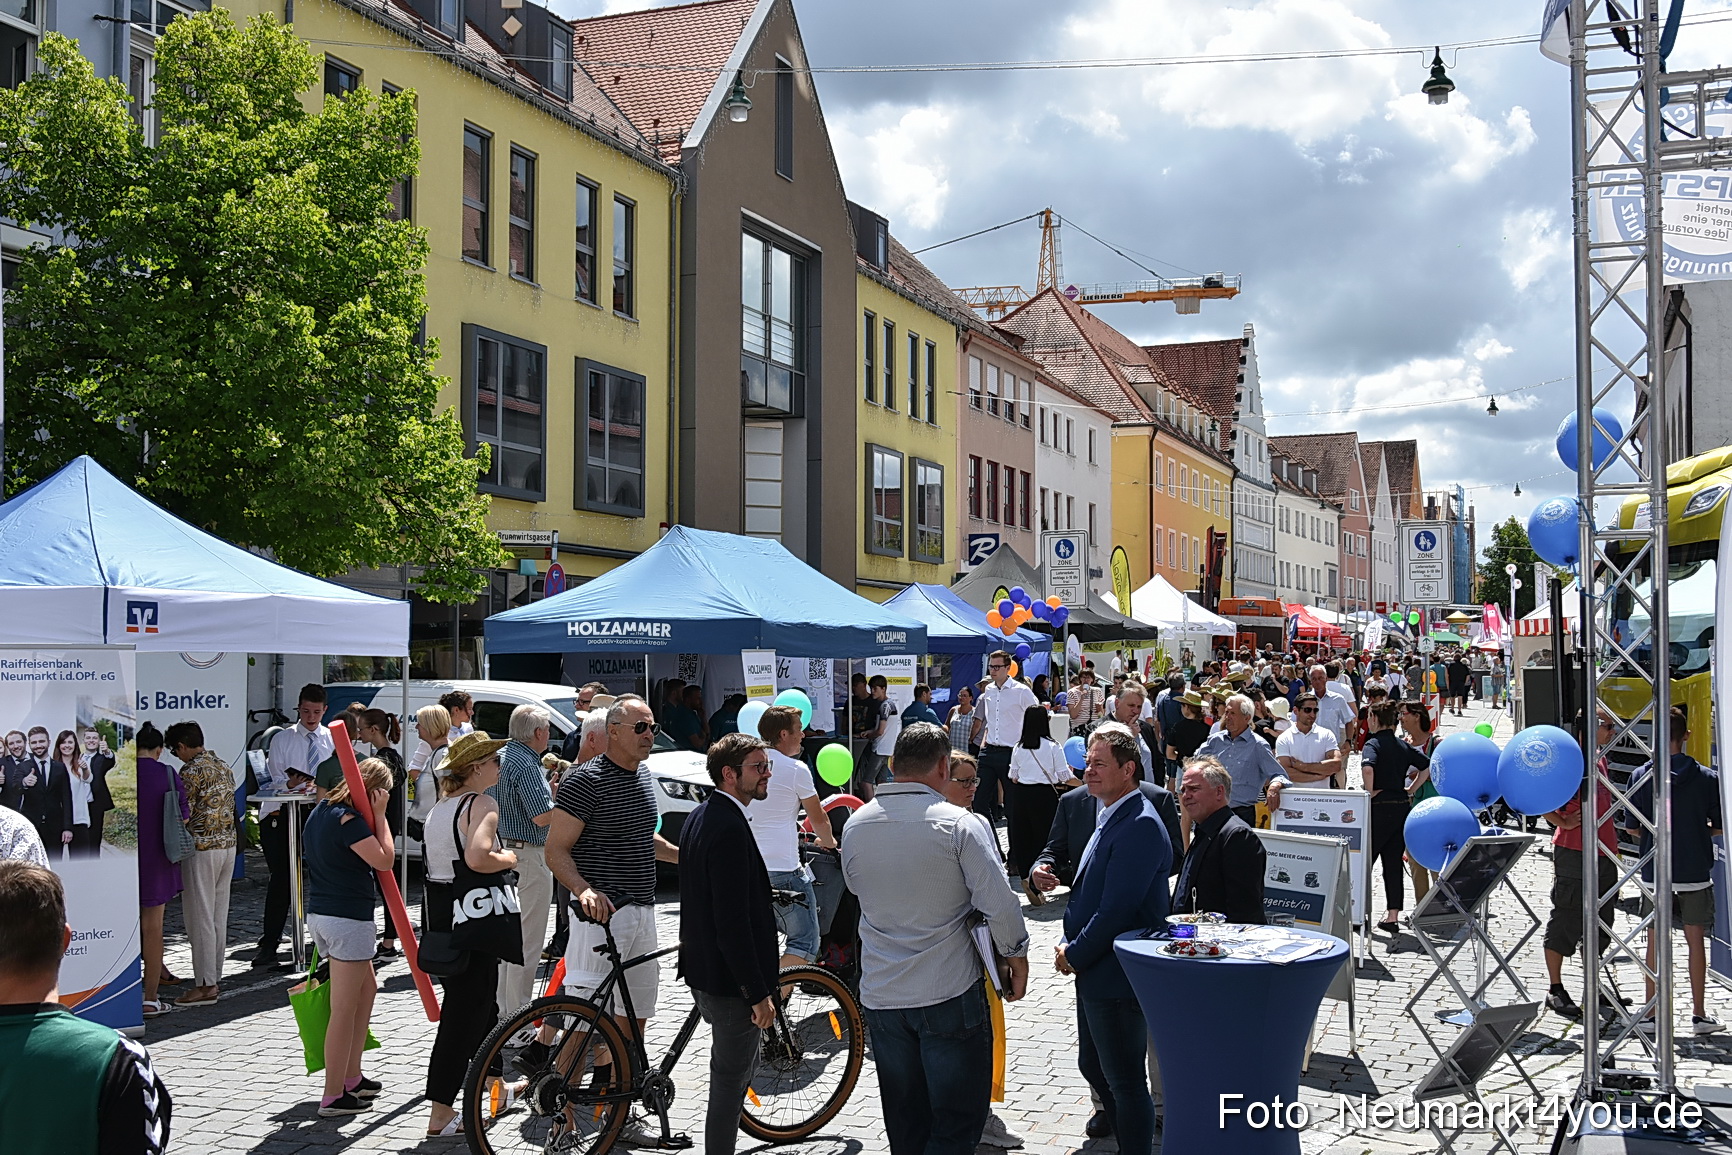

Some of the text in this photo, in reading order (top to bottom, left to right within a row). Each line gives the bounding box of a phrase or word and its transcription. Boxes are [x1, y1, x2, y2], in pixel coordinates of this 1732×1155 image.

[1082, 293, 1123, 301] LIEBHERR
[970, 537, 996, 562] R
[567, 621, 671, 637] HOLZAMMER
[876, 631, 907, 643] HOLZAMMER
[1, 659, 82, 669] Raiffeisenbank
[589, 659, 645, 674] HOLZAMME
[871, 658, 912, 666] HOLZAMMER
[747, 664, 772, 675] HOLZAMMER
[1, 671, 115, 681] Neumarkt i.d.OPf. eG
[155, 689, 229, 710] Banker.
[1263, 897, 1311, 910] agerist/in
[70, 928, 114, 941] Banker.
[64, 945, 88, 956] etzt!
